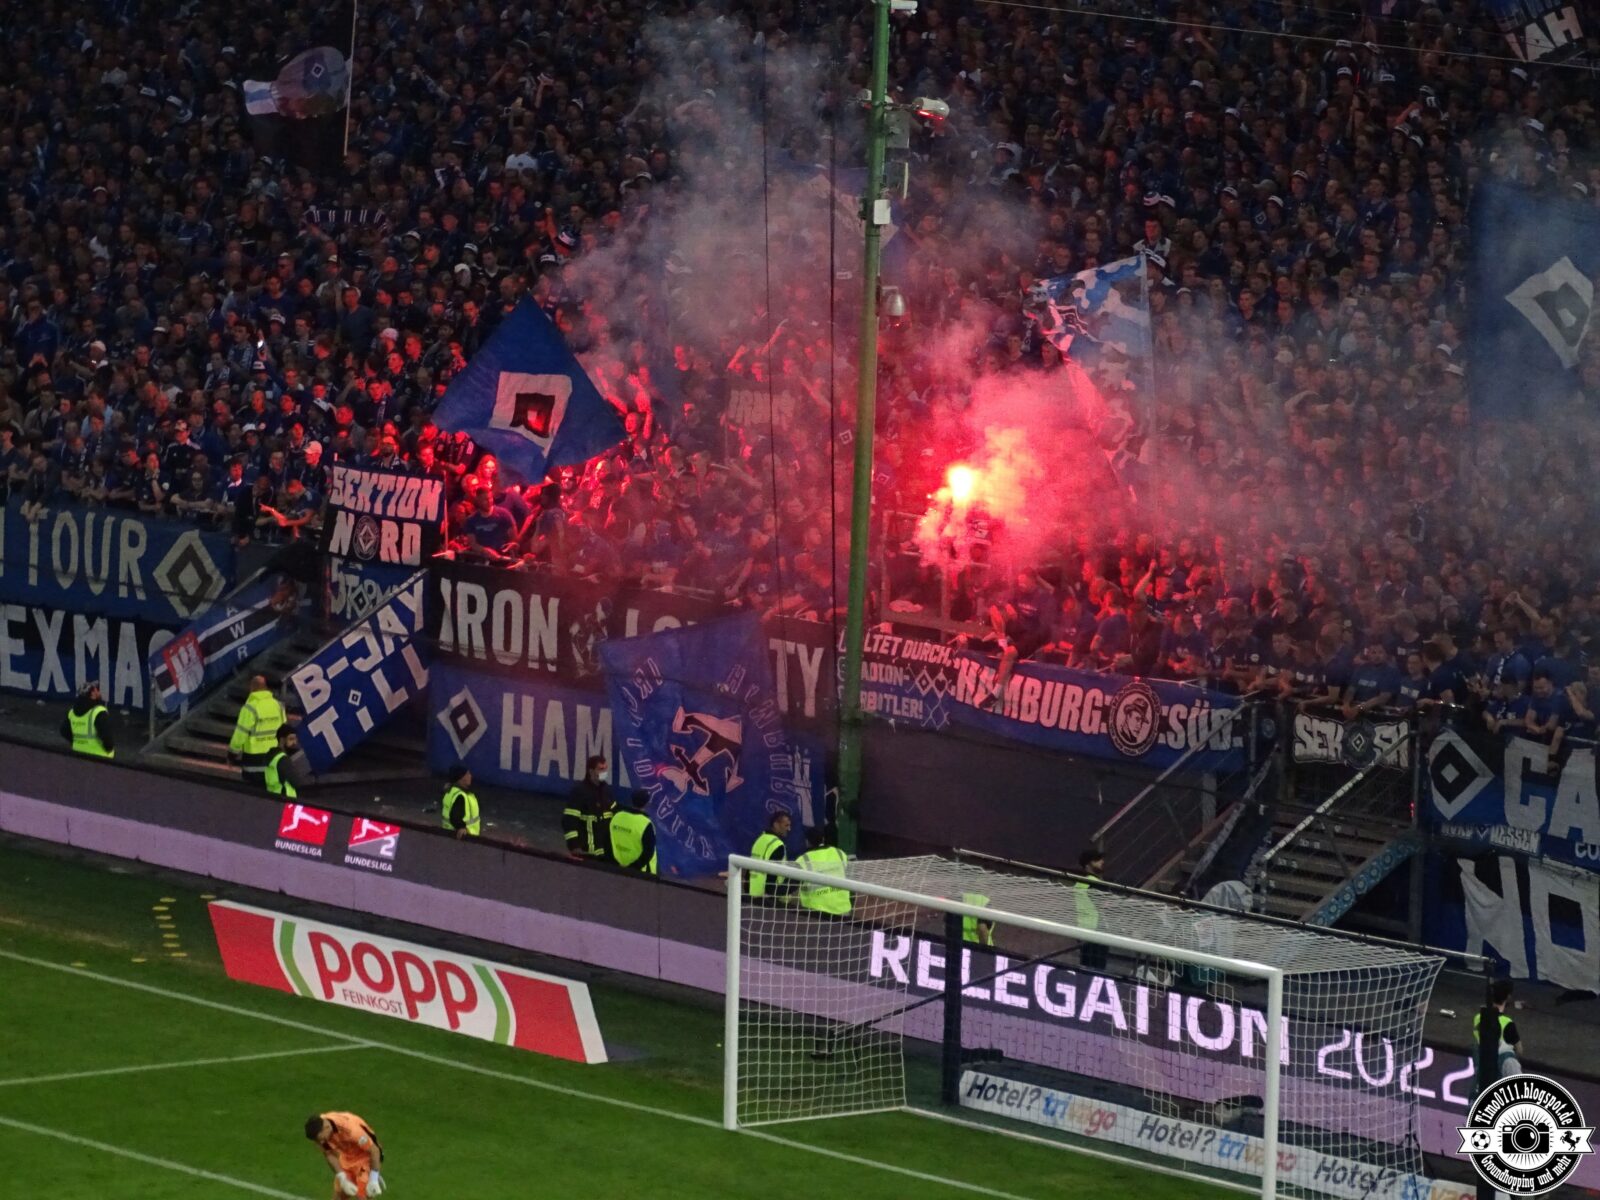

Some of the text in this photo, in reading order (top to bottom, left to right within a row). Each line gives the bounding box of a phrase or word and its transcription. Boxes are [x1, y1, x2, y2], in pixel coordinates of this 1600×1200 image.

[329, 466, 444, 521] SEKTION
[20, 502, 147, 600] TOUR
[439, 577, 560, 672] IRON
[275, 840, 322, 857] BUNDESLIGA
[344, 854, 393, 872] BUNDESLIGA
[308, 931, 478, 1031] POPP
[342, 988, 404, 1015] FEINKOST
[870, 930, 1475, 1106] RELEGATION 2022
[966, 1074, 1042, 1111] Hotel?
[1137, 1115, 1217, 1153] Hotel?
[1313, 1156, 1398, 1195] Hotel?
